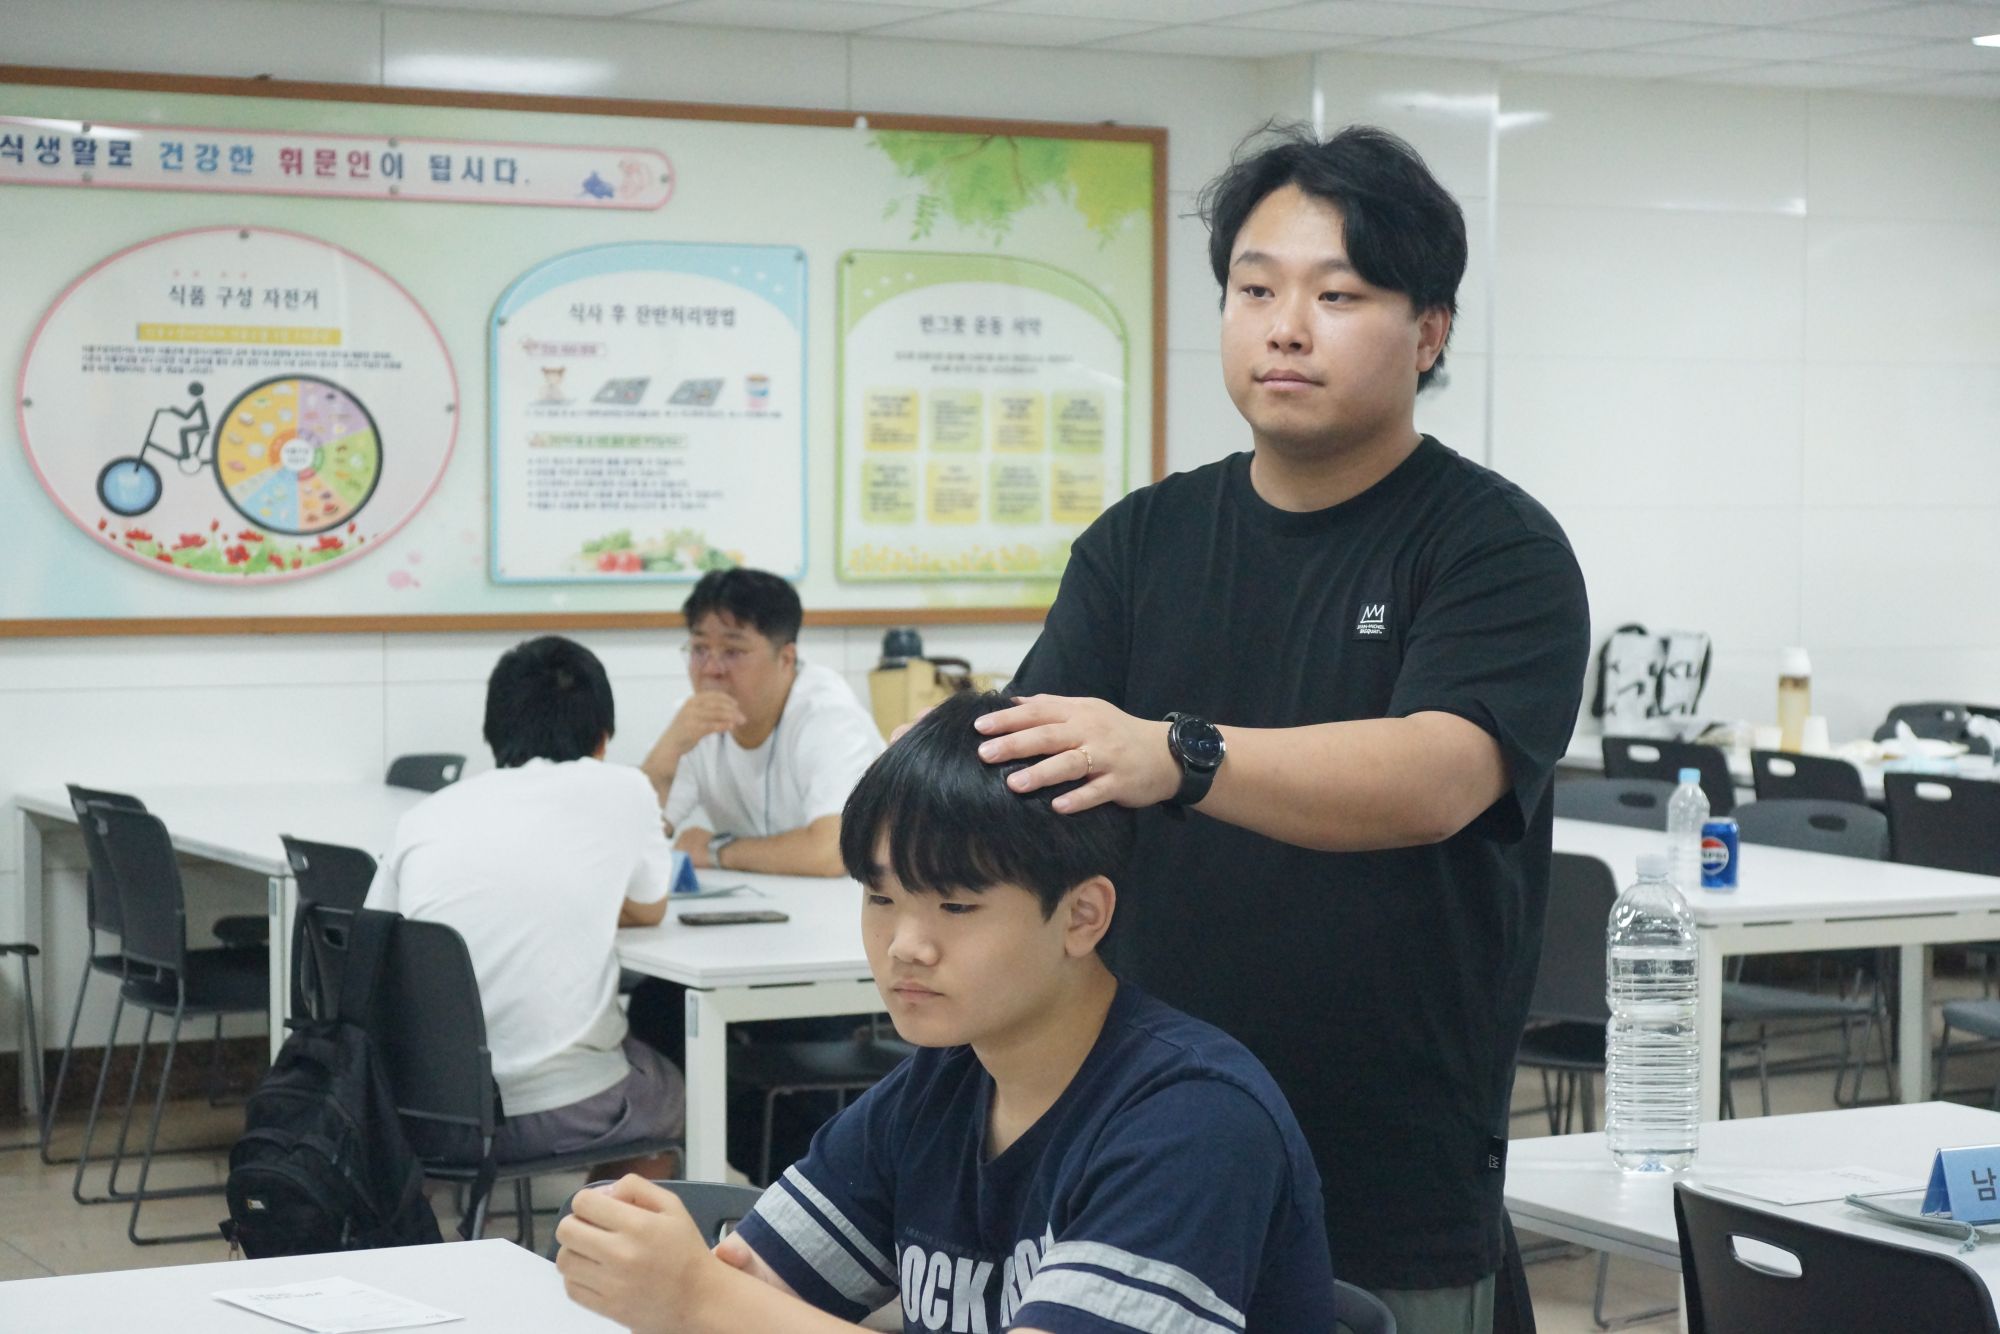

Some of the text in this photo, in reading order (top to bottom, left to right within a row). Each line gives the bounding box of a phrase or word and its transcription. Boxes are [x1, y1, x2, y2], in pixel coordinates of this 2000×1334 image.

[0, 134, 132, 166] 식생활로
[159, 141, 255, 173] 건강한
[279, 147, 404, 179] 휘문인이
[168, 285, 319, 311] 식품 구성 자전거
[569, 303, 602, 325] 식사
[1971, 1167, 1997, 1201] 남
[895, 1241, 995, 1334] OCK
